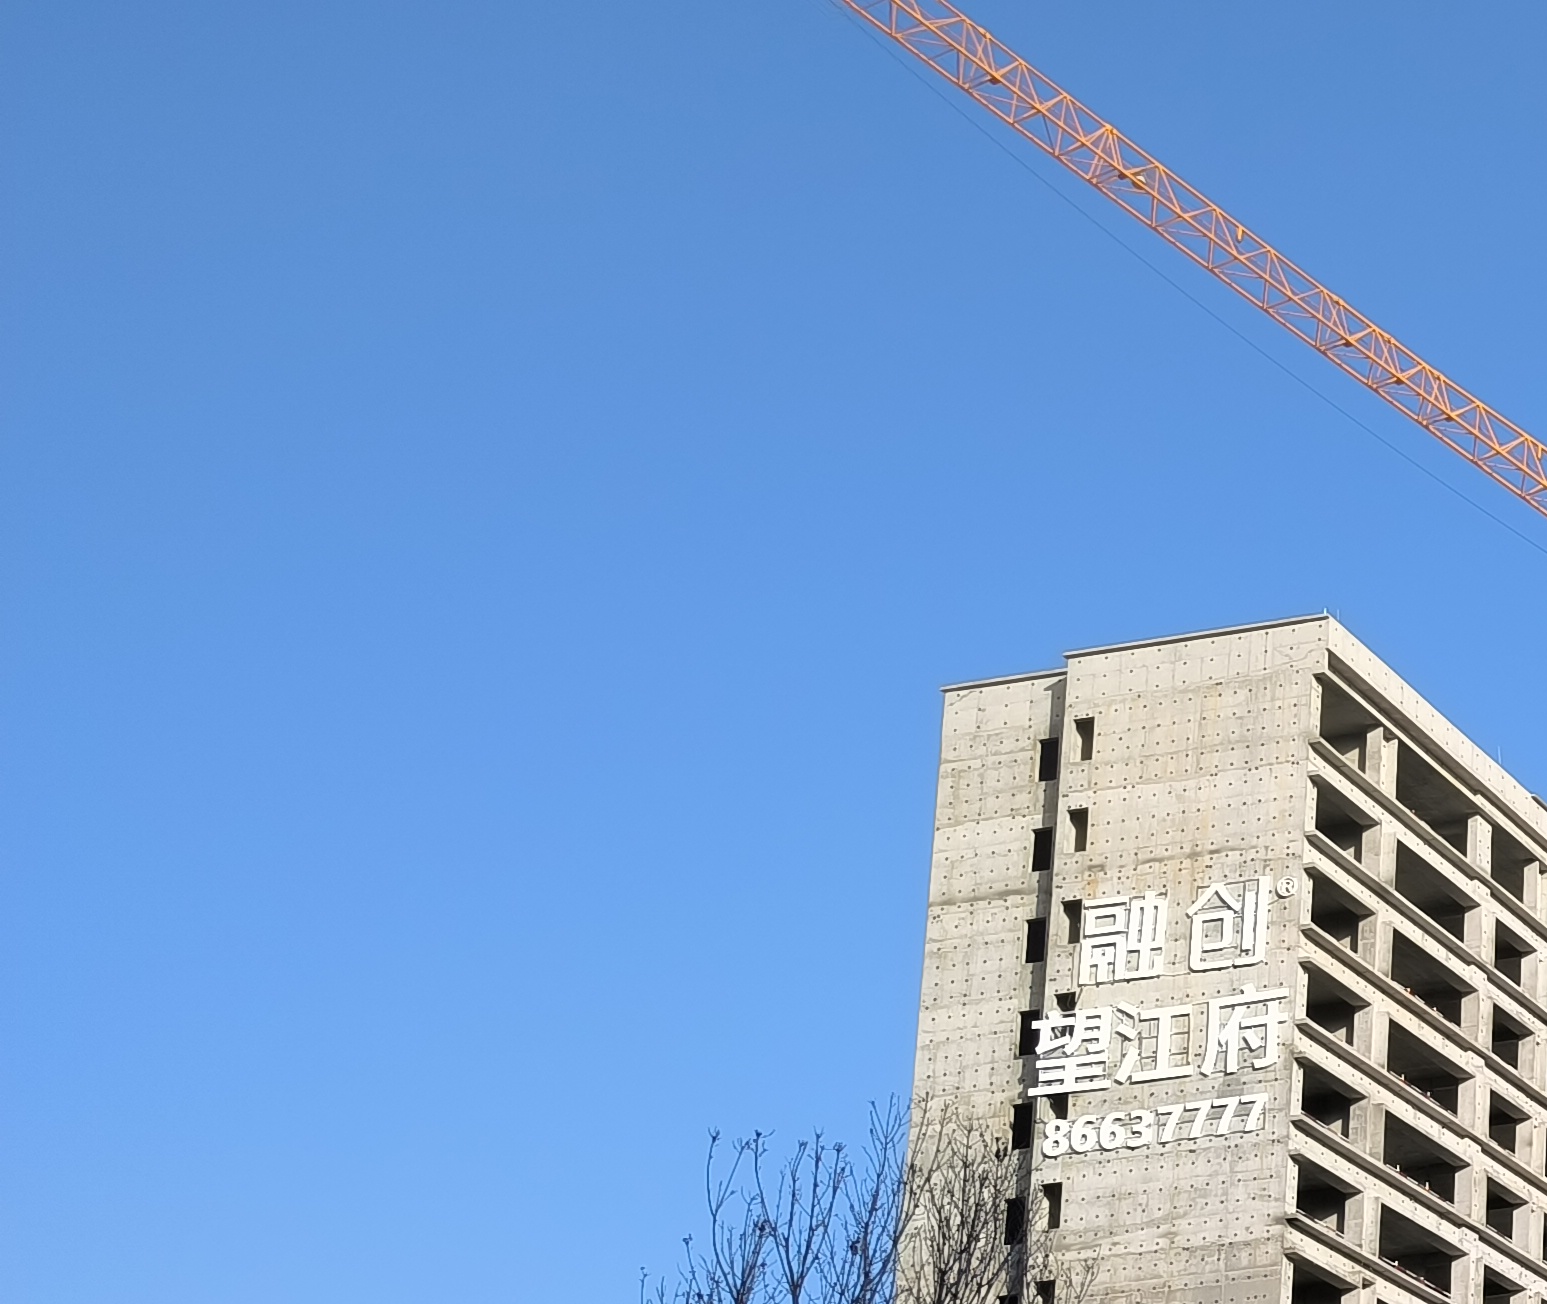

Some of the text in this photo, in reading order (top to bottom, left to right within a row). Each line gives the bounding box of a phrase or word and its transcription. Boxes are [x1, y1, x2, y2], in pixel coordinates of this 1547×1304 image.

[1078, 876, 1271, 985] 融创
[1028, 985, 1290, 1096] 望江府
[1042, 1095, 1268, 1157] 86637777
